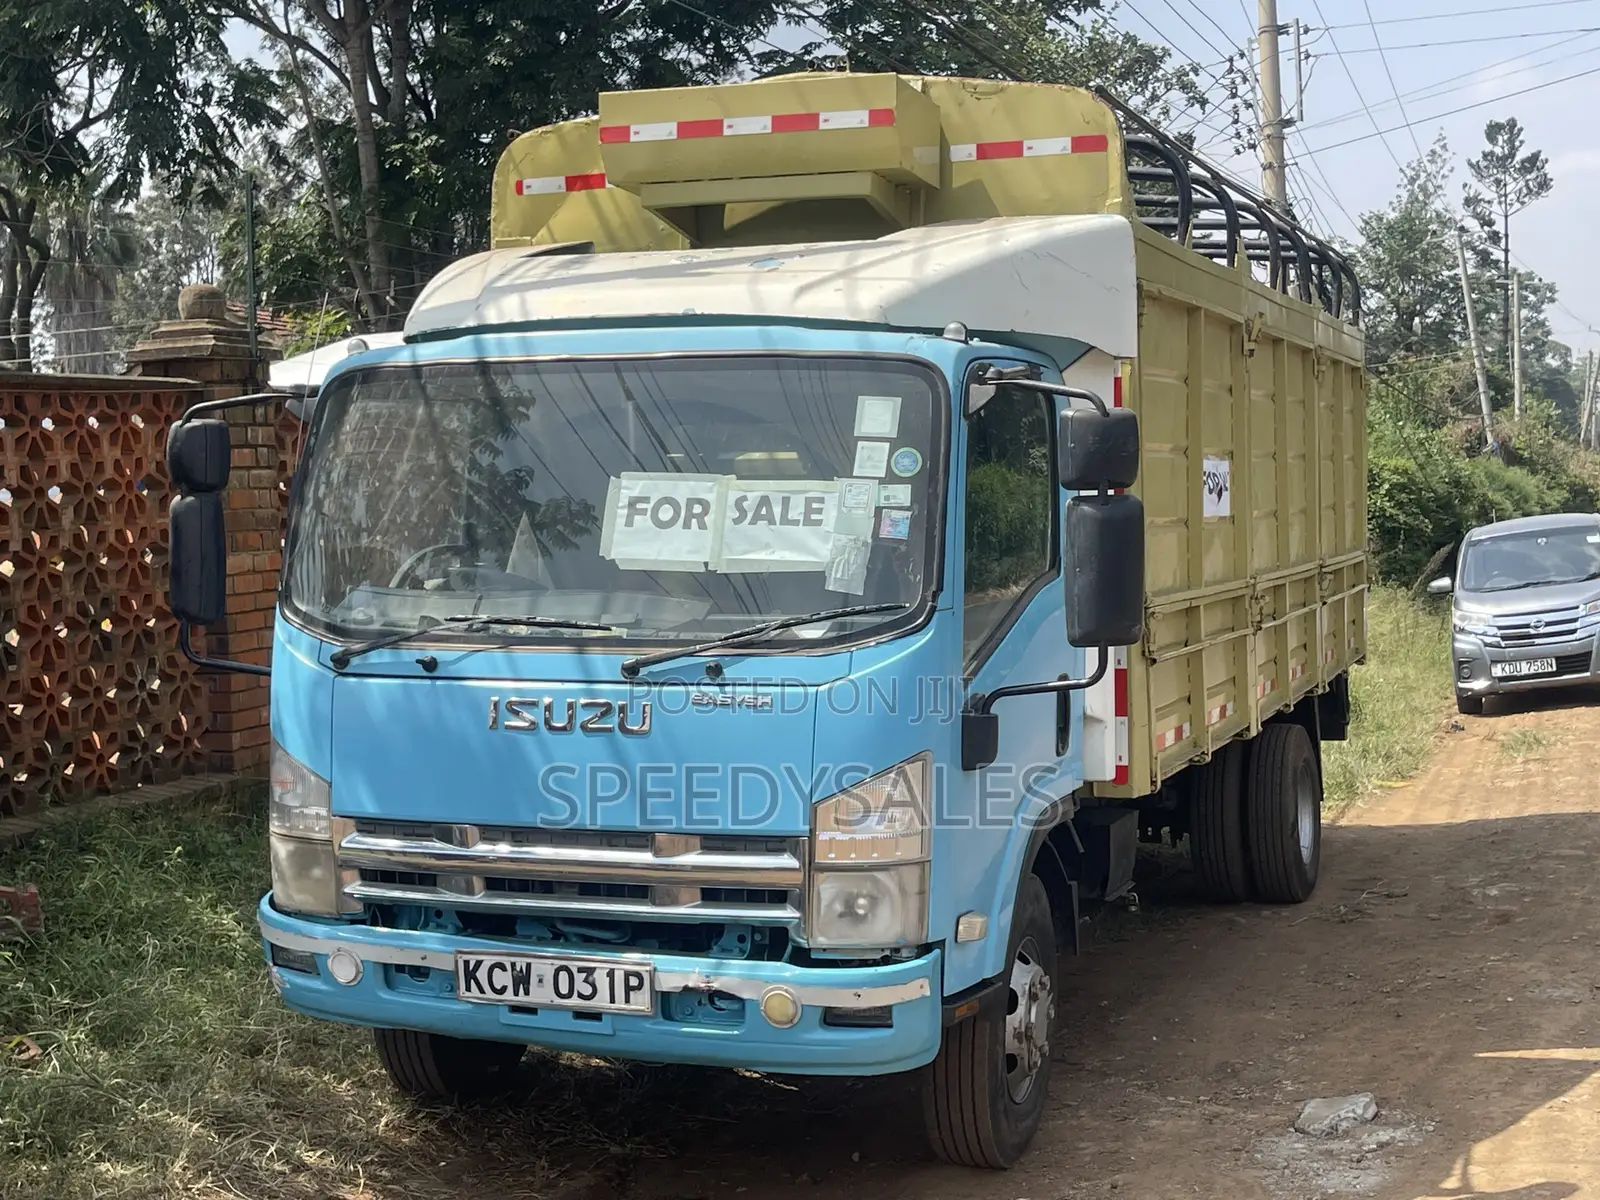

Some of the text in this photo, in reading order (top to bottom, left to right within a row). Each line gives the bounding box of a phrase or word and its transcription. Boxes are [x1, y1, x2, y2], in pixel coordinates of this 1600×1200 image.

[623, 494, 826, 531] FOR SALE
[1501, 659, 1554, 675] KDU 758N
[488, 695, 653, 735] ISUZU
[463, 959, 645, 1005] KCW 031P
